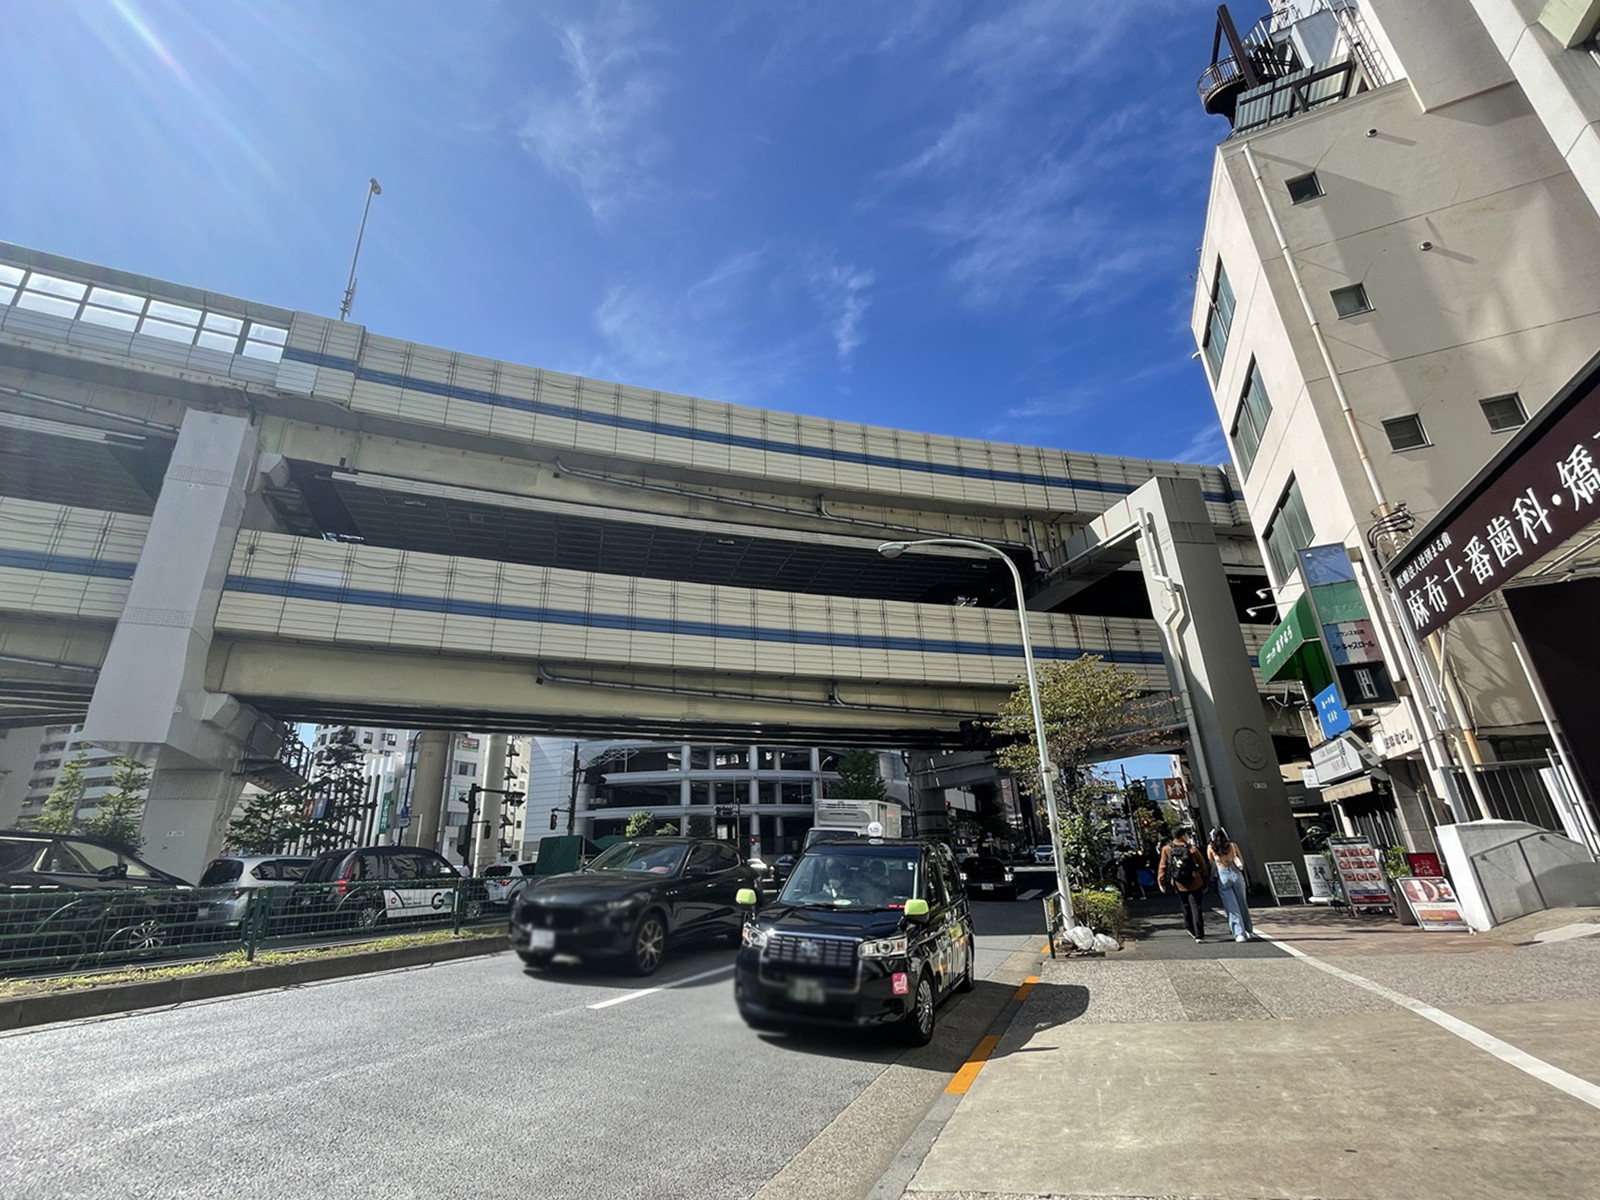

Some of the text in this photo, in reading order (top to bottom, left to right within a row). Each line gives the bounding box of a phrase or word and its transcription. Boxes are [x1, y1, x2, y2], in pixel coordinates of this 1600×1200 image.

[1406, 432, 1600, 631] 麻布十番歯科・矯
